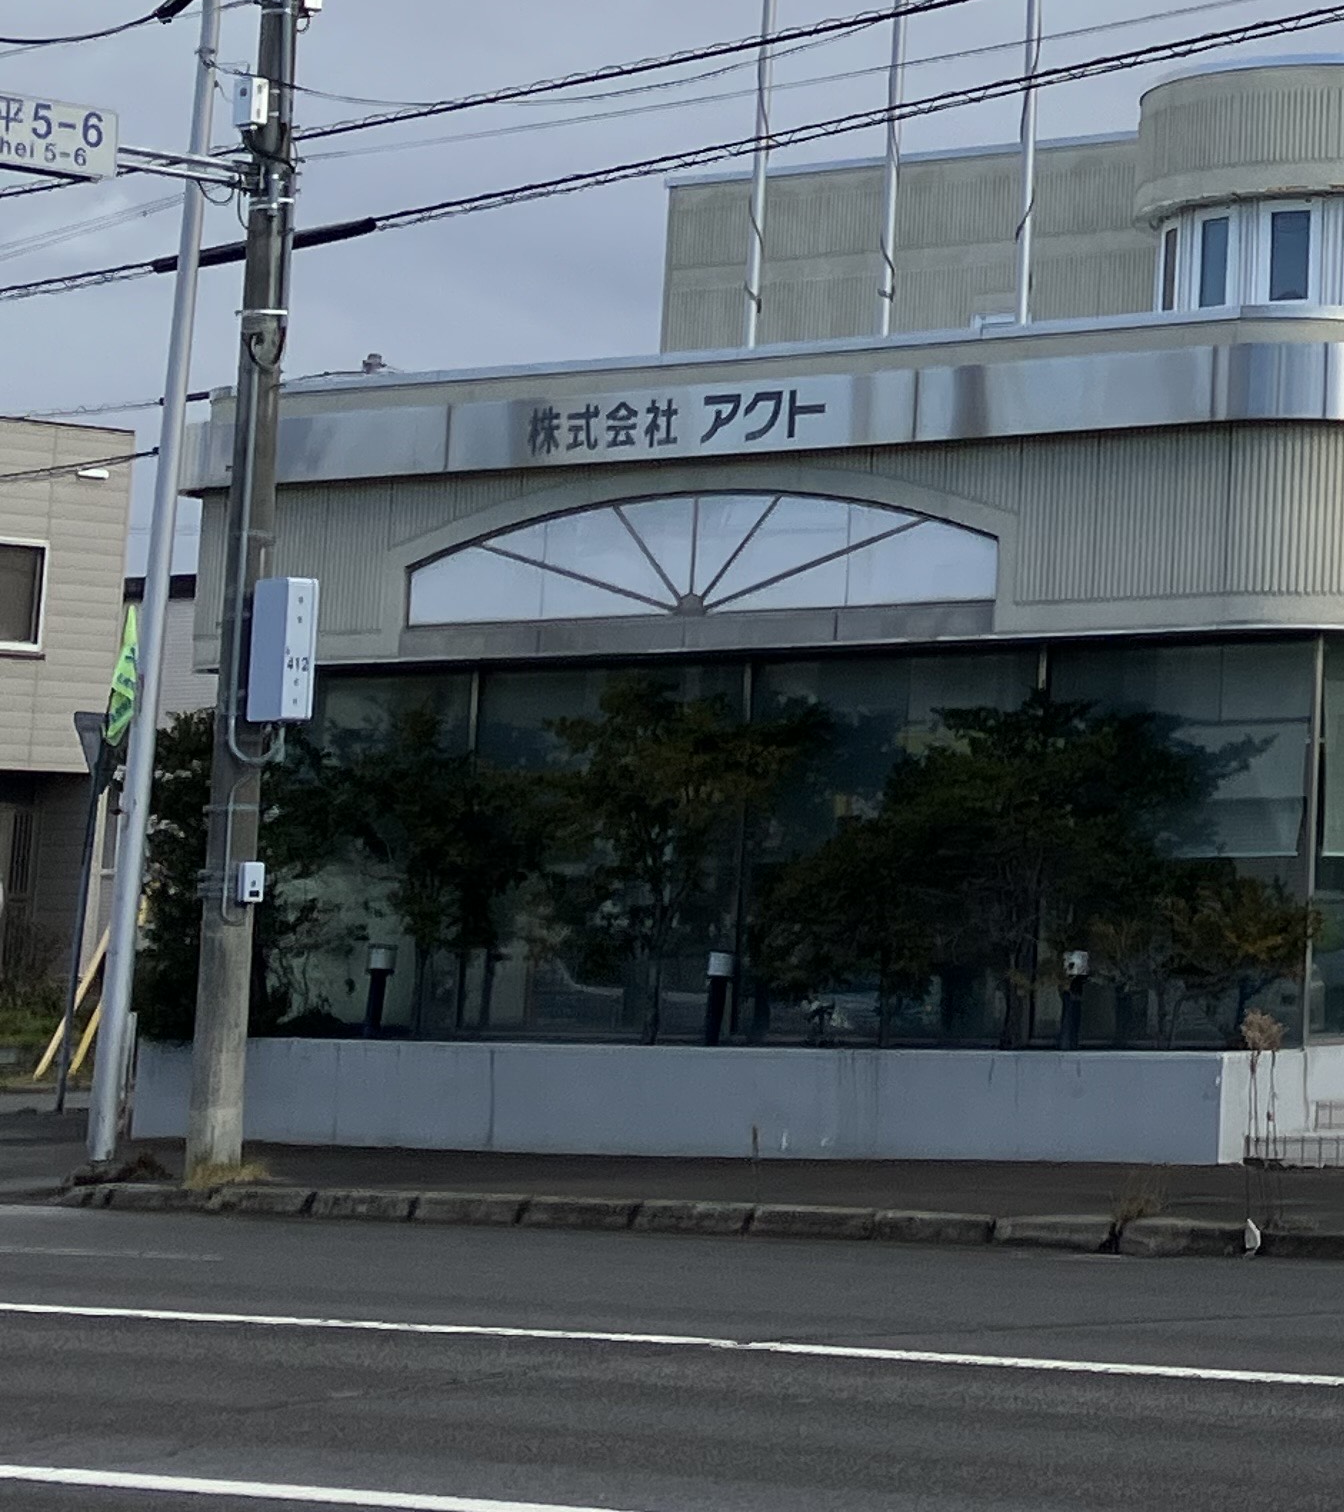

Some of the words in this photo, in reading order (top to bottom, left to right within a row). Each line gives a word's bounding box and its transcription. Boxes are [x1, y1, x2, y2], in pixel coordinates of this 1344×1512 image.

[527, 398, 679, 455] 株式会社
[700, 389, 826, 444] アクト
